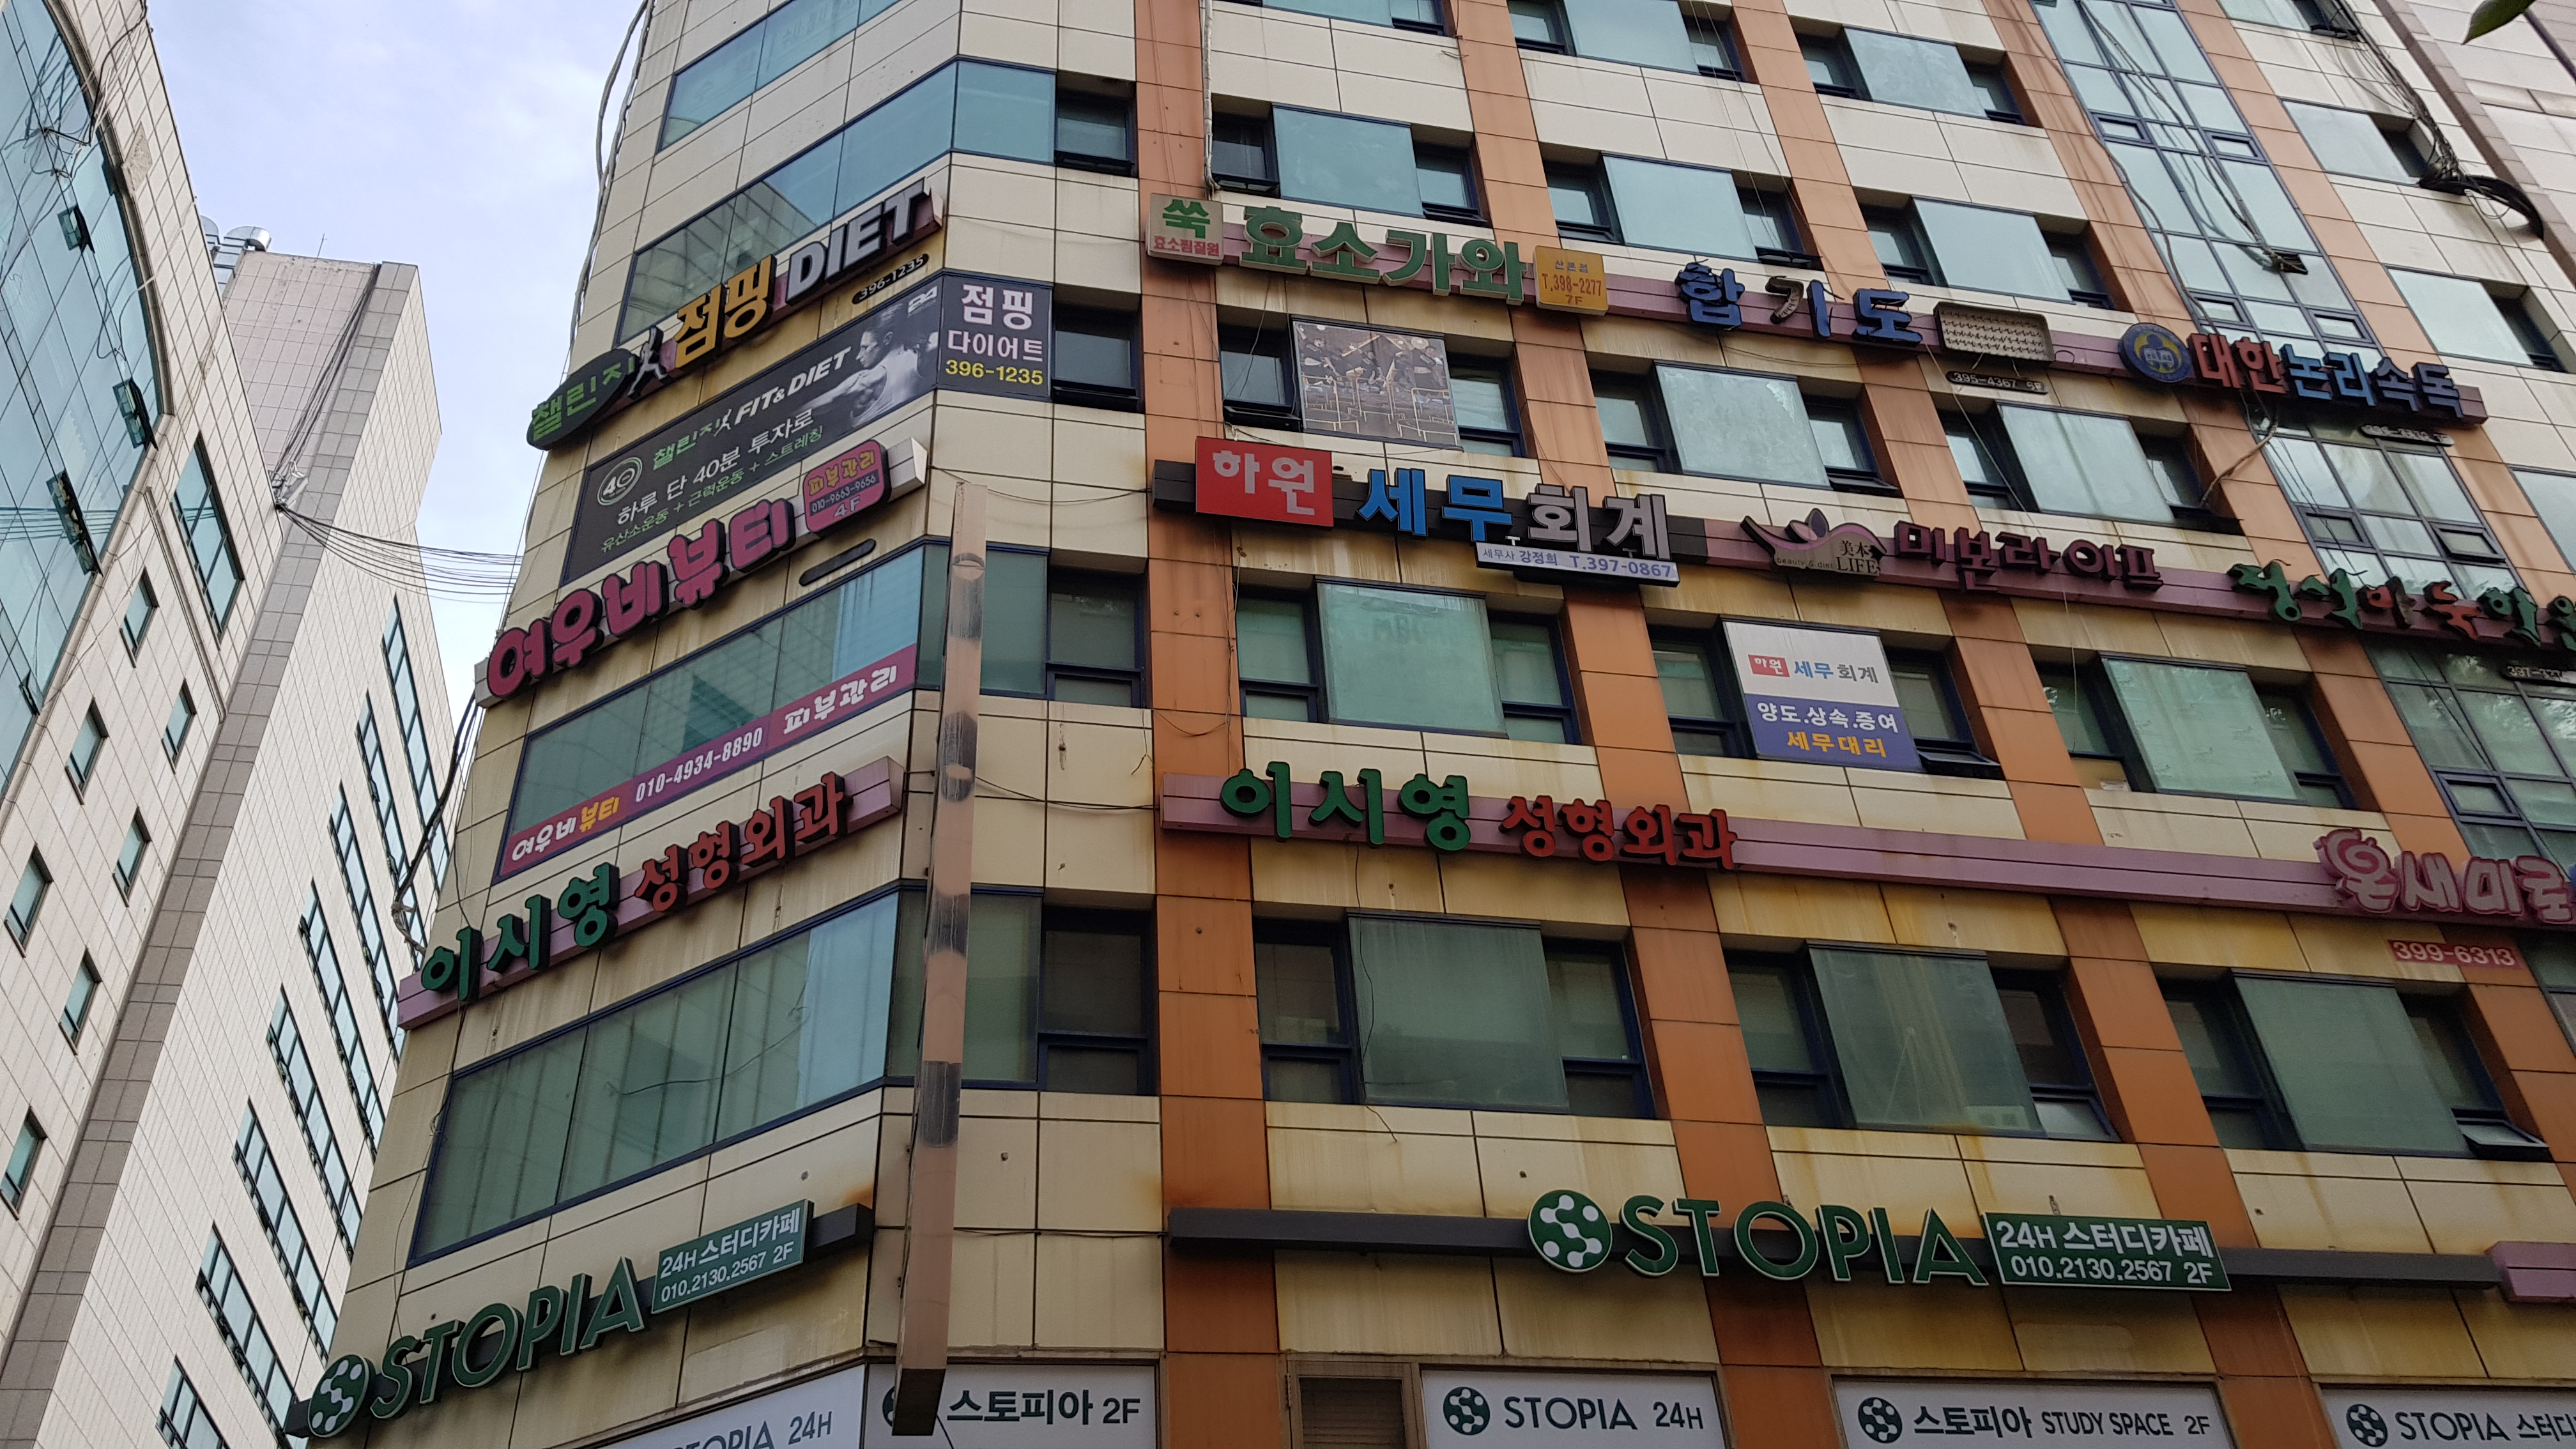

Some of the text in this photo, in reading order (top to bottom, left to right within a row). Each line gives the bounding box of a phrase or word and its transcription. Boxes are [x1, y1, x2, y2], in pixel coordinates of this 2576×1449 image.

[1163, 199, 1210, 239] 쑥
[859, 256, 924, 301] 396-1235
[1239, 206, 1529, 306] 효소가와
[532, 178, 926, 436] 챌린지 점핑 DIET
[962, 284, 1033, 330] 점핑
[1565, 295, 1583, 305] 7F
[1675, 260, 1922, 344] 합기도
[947, 330, 1044, 363] 다이어트
[946, 360, 1043, 386] 396-1235
[618, 408, 814, 525] 하루 단 40분 투자로
[653, 418, 721, 471] 챌린지
[601, 506, 669, 553] 유산소운동
[688, 469, 744, 507] 근력운동
[764, 425, 824, 466] 스트레칭
[808, 450, 875, 496] 피부관리
[812, 475, 876, 512] 010-9663-9656
[1212, 449, 1316, 516] 하원
[833, 495, 861, 518] 4F
[1483, 548, 1515, 560] 세무사
[1519, 551, 1558, 566] 강정희
[1836, 556, 1878, 574] LIFE
[1894, 520, 2164, 592] 미본라이프
[487, 497, 794, 698] 여우비뷰티
[636, 727, 763, 802] 010-4934-8890
[784, 664, 897, 735] 피부관리
[1787, 731, 1886, 758] 세무대리
[1220, 761, 1738, 870] 이시영 성형외과
[421, 770, 852, 1002] 이시영 성형외과
[2393, 942, 2516, 967] 399-6313
[662, 1207, 801, 1278] 24H 스터디카페
[1620, 1195, 1989, 1287] STOPIA
[2000, 1220, 2213, 1259] 24H 스터디카페
[661, 1241, 794, 1303] 010.2130.2567 2F
[2010, 1254, 2212, 1285] 010.2130.2567 2F
[371, 1257, 645, 1420] STOPIA
[788, 1411, 832, 1445] 24H
[946, 1389, 1141, 1425] 스토피아 2F
[1505, 1396, 1703, 1430] STOPIA 24H
[1914, 1406, 2211, 1438] 스토피아 STUDY SPACE 2F
[2396, 1412, 2576, 1441] STOPIA 스터디
